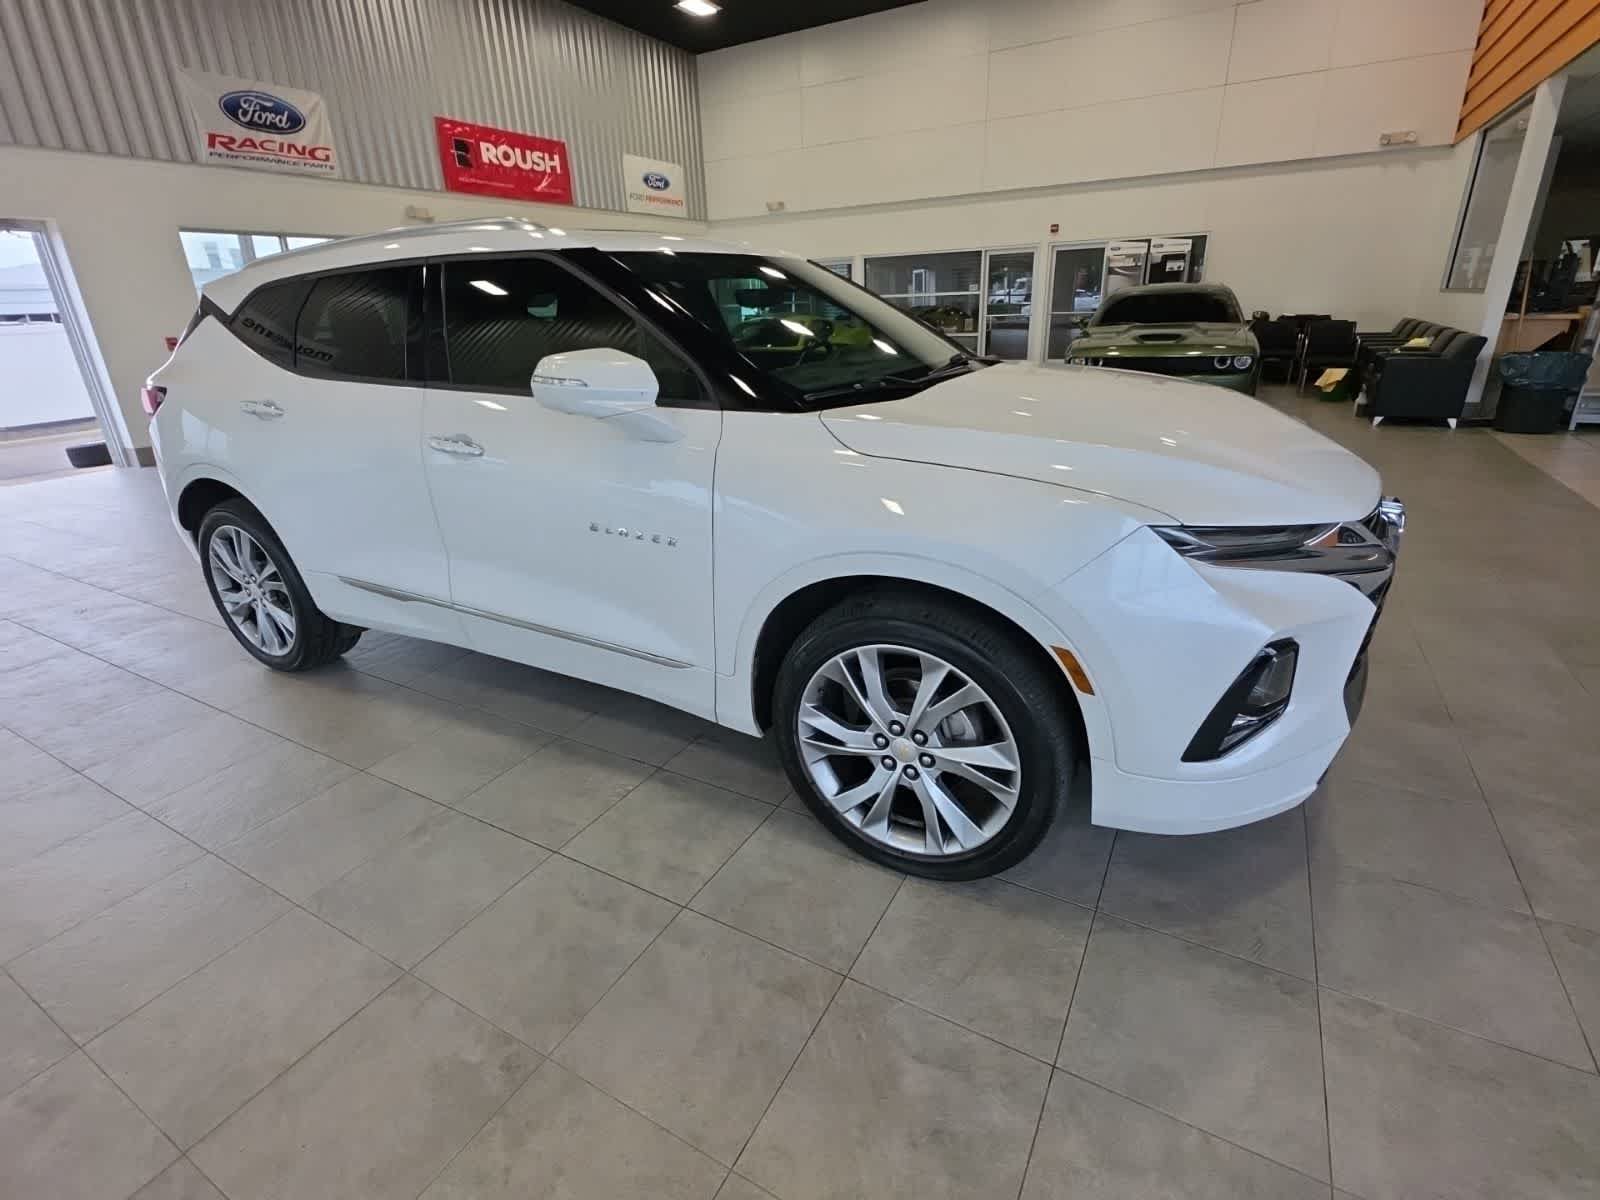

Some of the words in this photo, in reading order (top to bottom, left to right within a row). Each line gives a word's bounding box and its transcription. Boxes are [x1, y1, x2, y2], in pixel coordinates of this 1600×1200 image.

[238, 96, 291, 129] Ford
[207, 132, 331, 163] RACING
[209, 151, 299, 167] PERFORMANCE
[303, 161, 335, 171] PARTS
[479, 140, 561, 174] ROUSH
